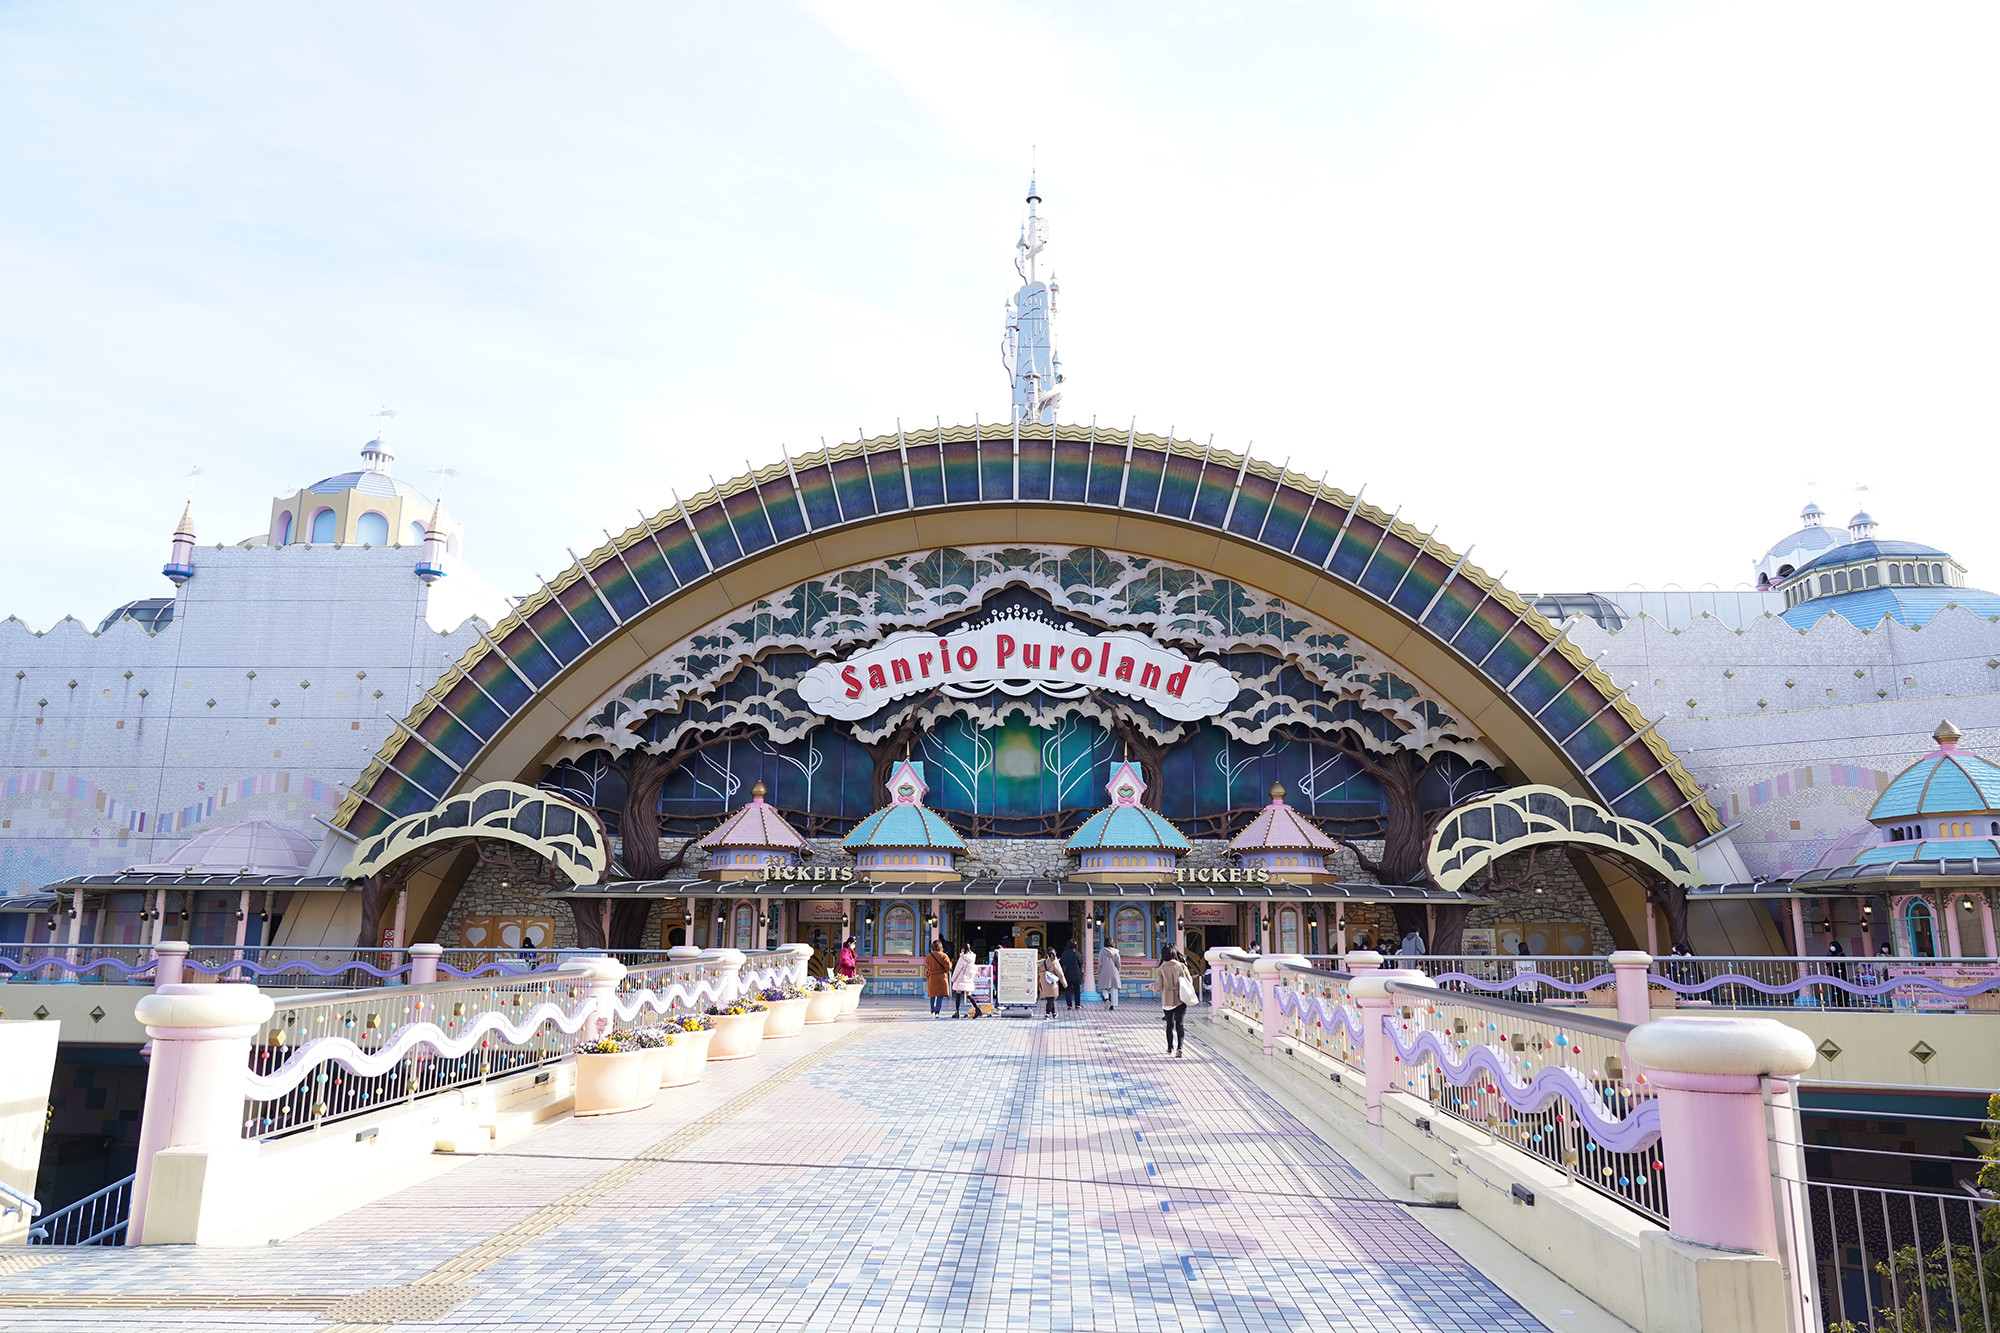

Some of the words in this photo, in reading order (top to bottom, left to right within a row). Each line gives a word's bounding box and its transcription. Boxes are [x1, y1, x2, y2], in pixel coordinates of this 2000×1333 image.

[840, 638, 979, 698] Sanrio
[996, 634, 1192, 698] Puroland
[762, 865, 853, 881] TICKETS
[1174, 867, 1270, 883] TICKETS
